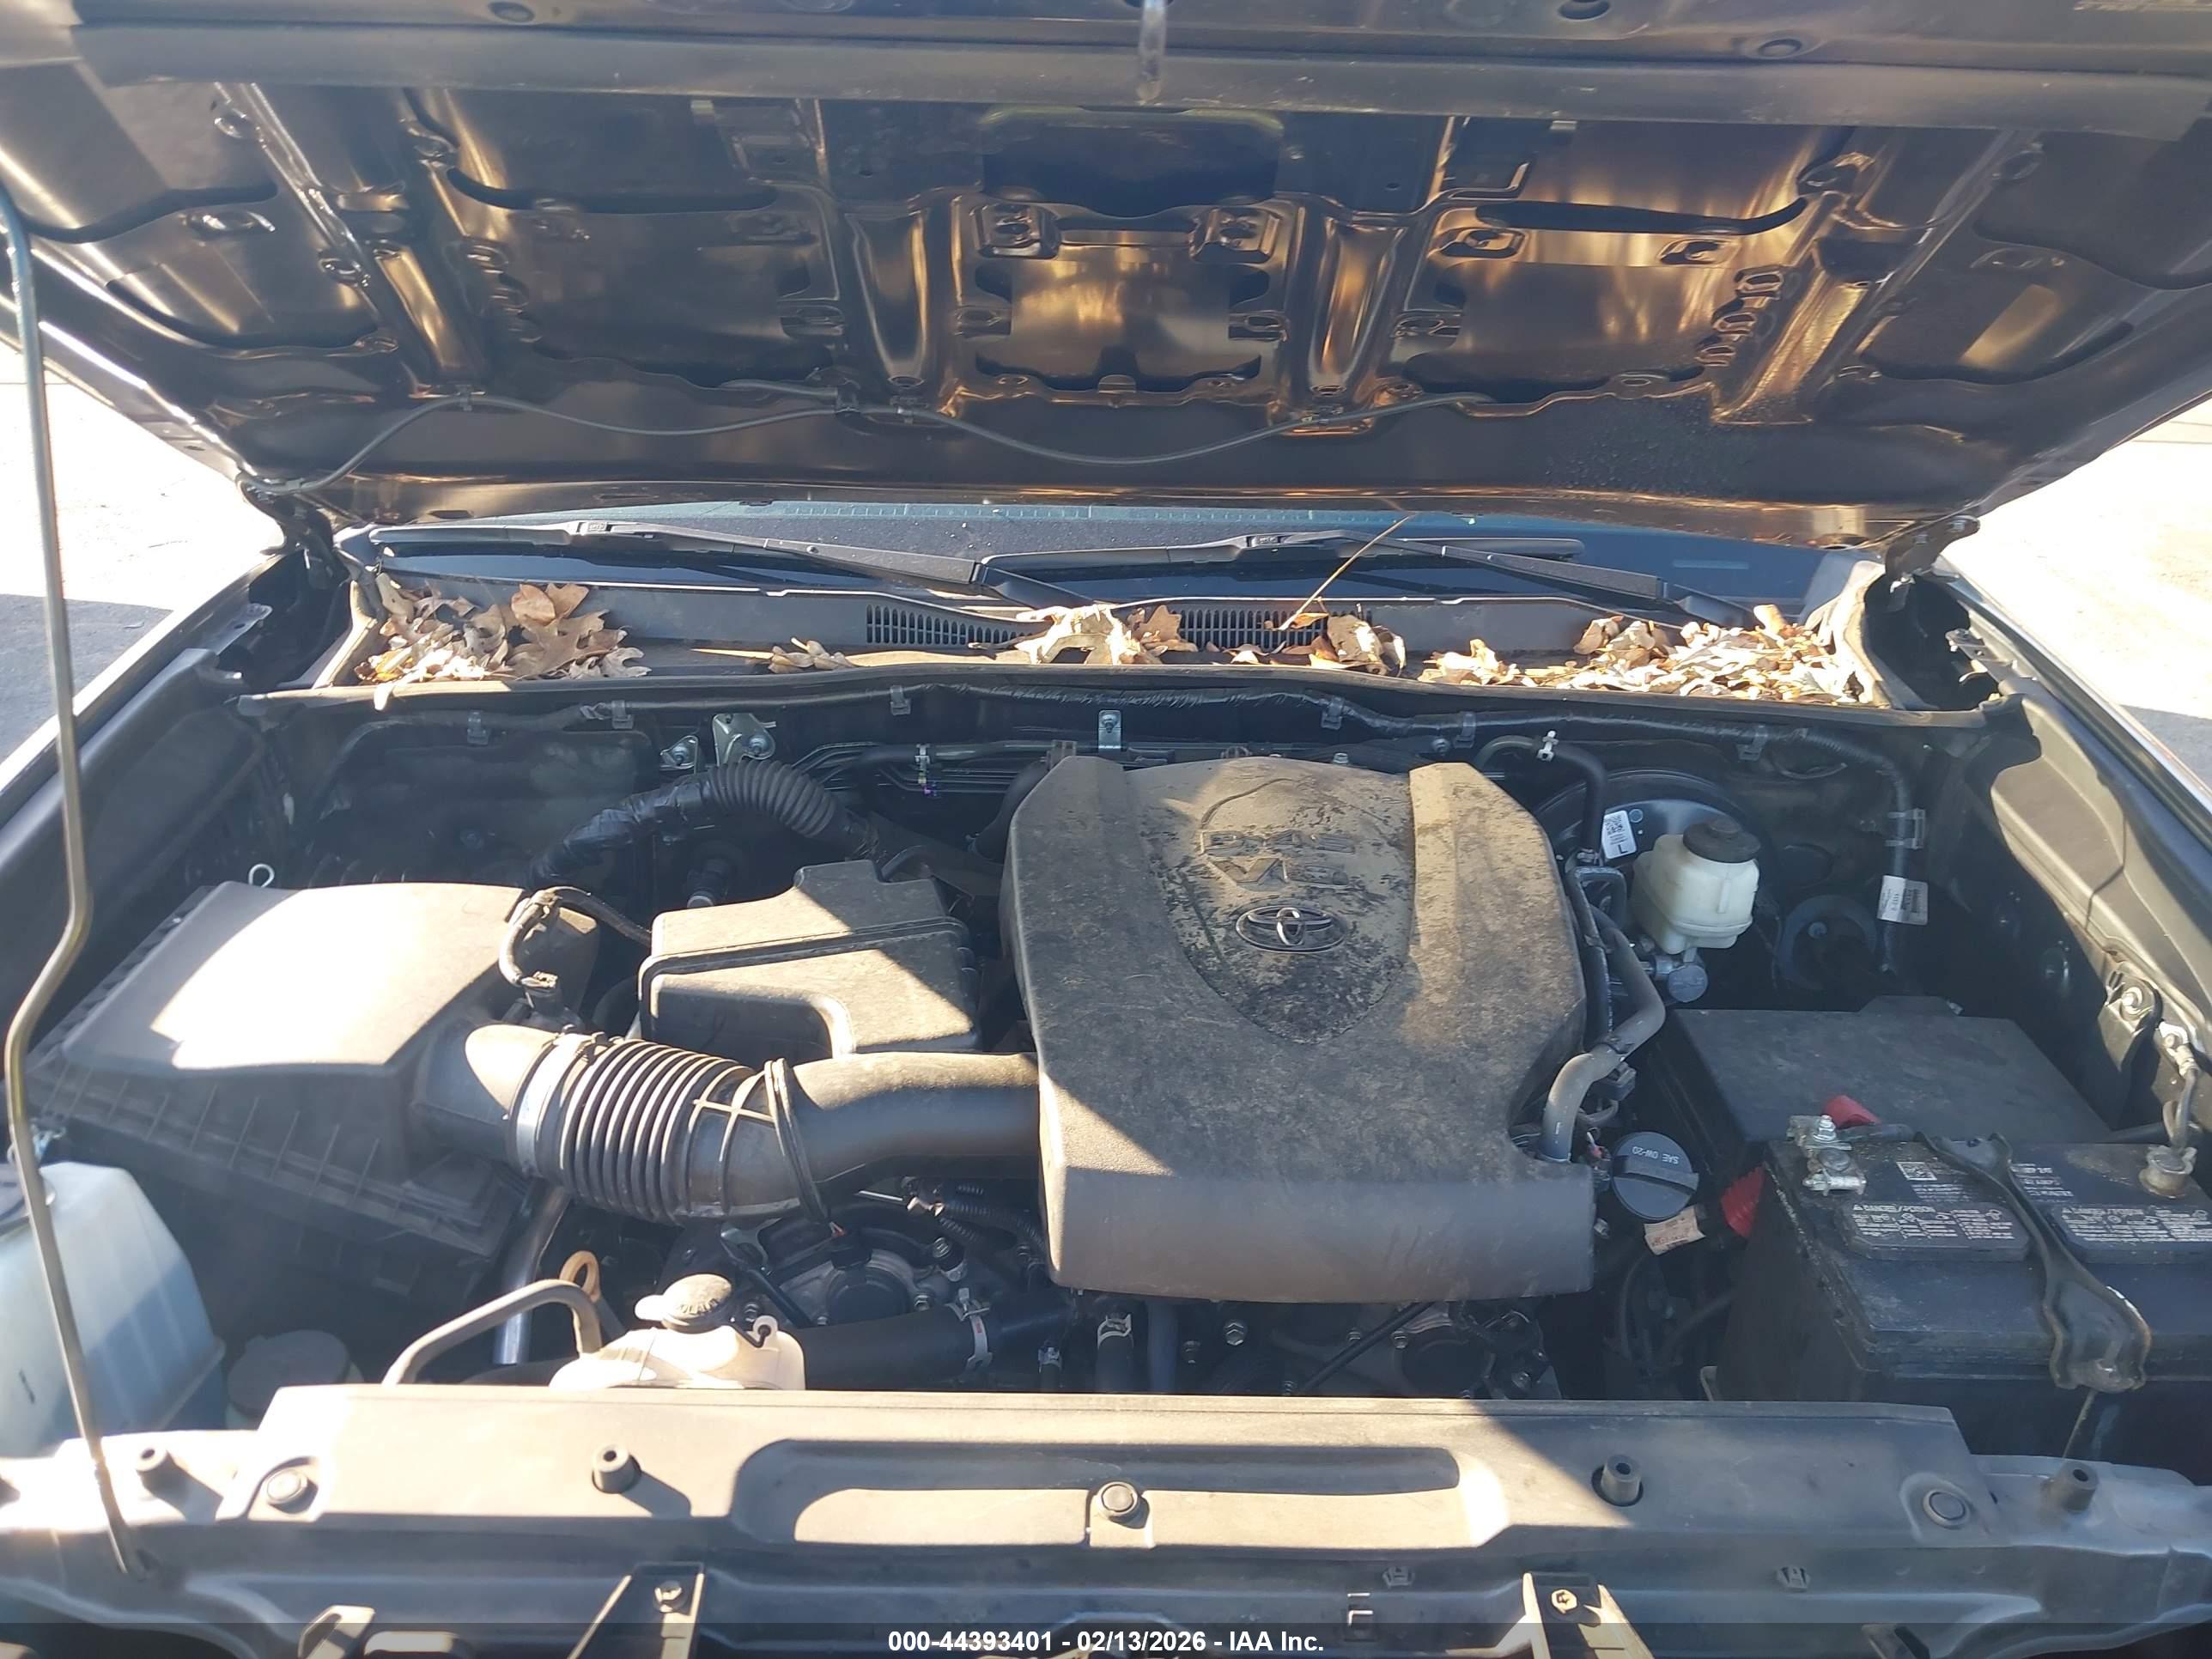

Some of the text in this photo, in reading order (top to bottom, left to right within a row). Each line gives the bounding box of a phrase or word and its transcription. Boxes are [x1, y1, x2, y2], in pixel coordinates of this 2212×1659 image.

[1618, 844, 1629, 854] L
[1632, 1146, 1680, 1164] SAE 0W-20
